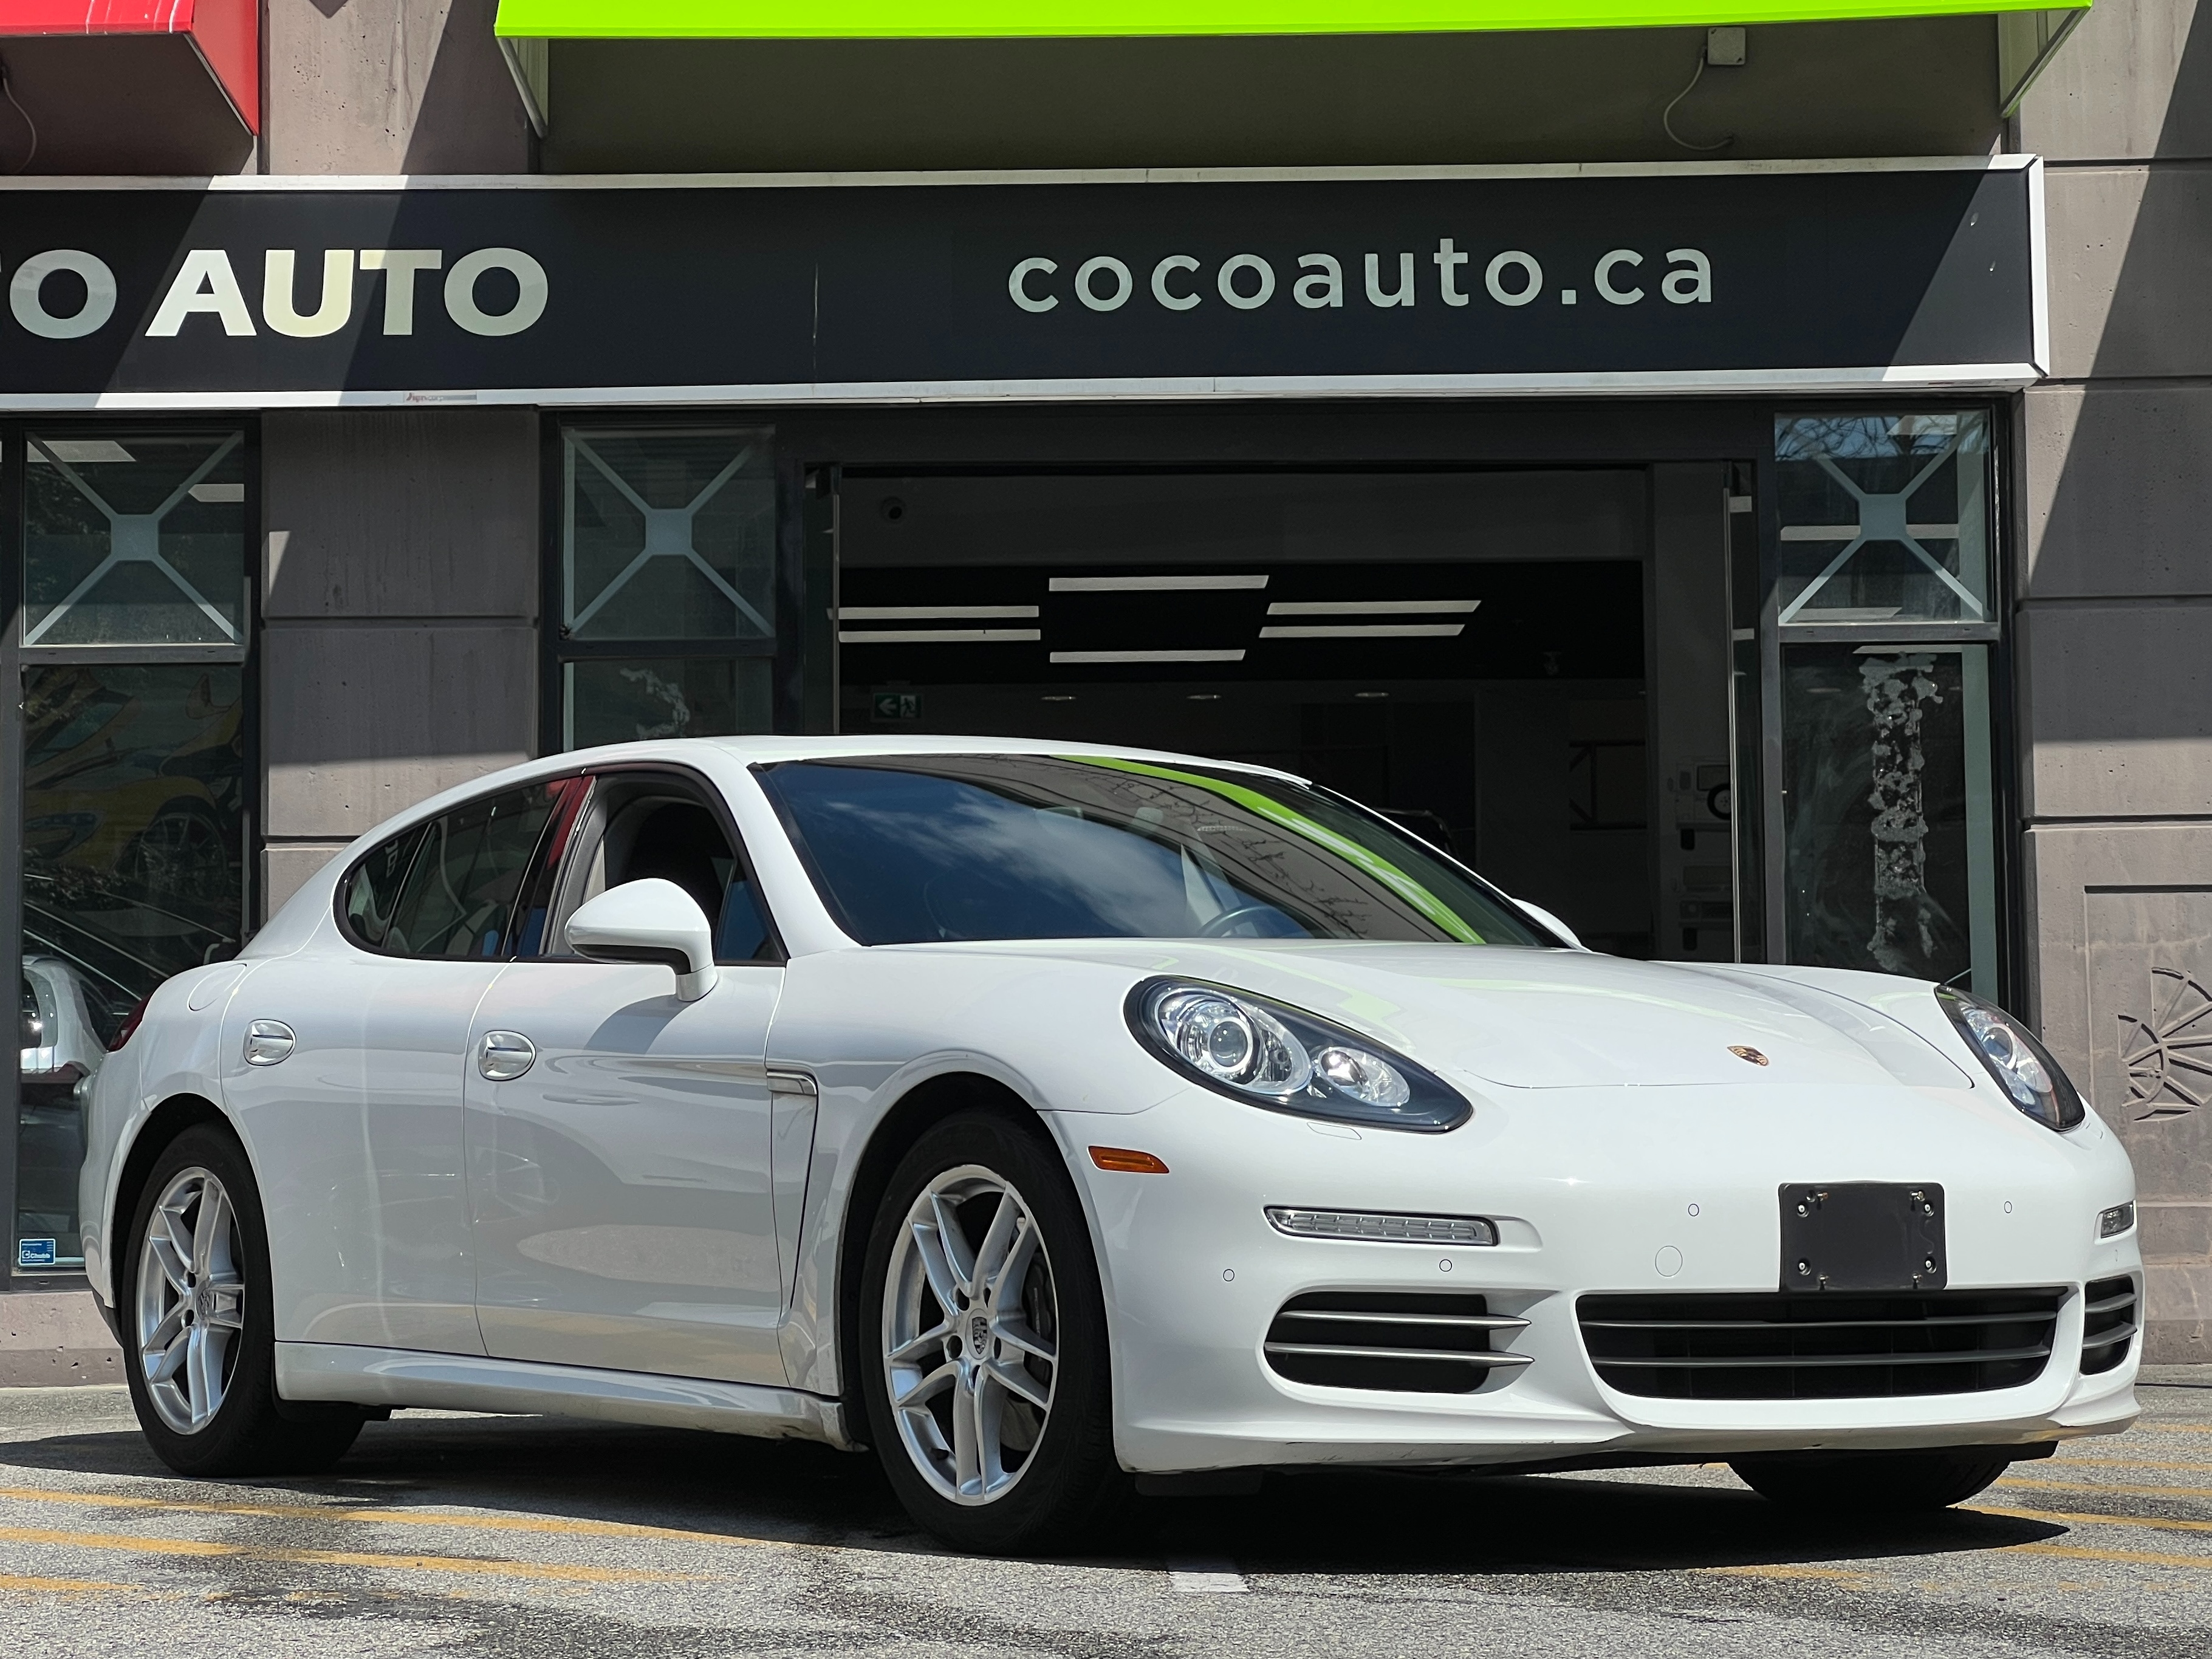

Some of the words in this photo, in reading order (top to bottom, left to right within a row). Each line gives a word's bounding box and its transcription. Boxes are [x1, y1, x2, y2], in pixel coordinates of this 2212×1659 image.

[0, 249, 117, 339] O
[145, 247, 549, 338] AUTO
[1008, 238, 1711, 313] cocoauto.ca
